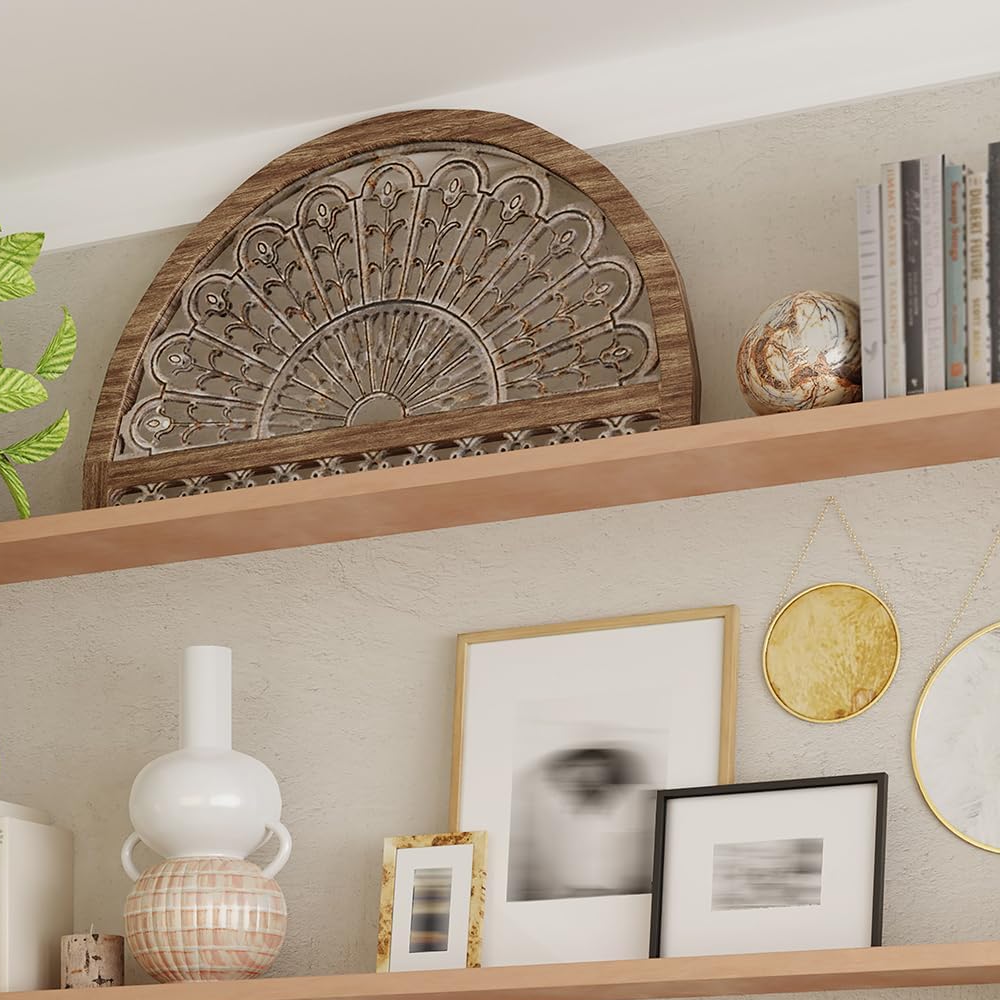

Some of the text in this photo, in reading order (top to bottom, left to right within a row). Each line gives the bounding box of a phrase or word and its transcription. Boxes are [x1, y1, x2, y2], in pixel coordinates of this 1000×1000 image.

[886, 168, 897, 209] JIMMY
[969, 187, 983, 235] DILBERT
[887, 215, 898, 268] CARTER
[970, 238, 983, 282] FUTURE
